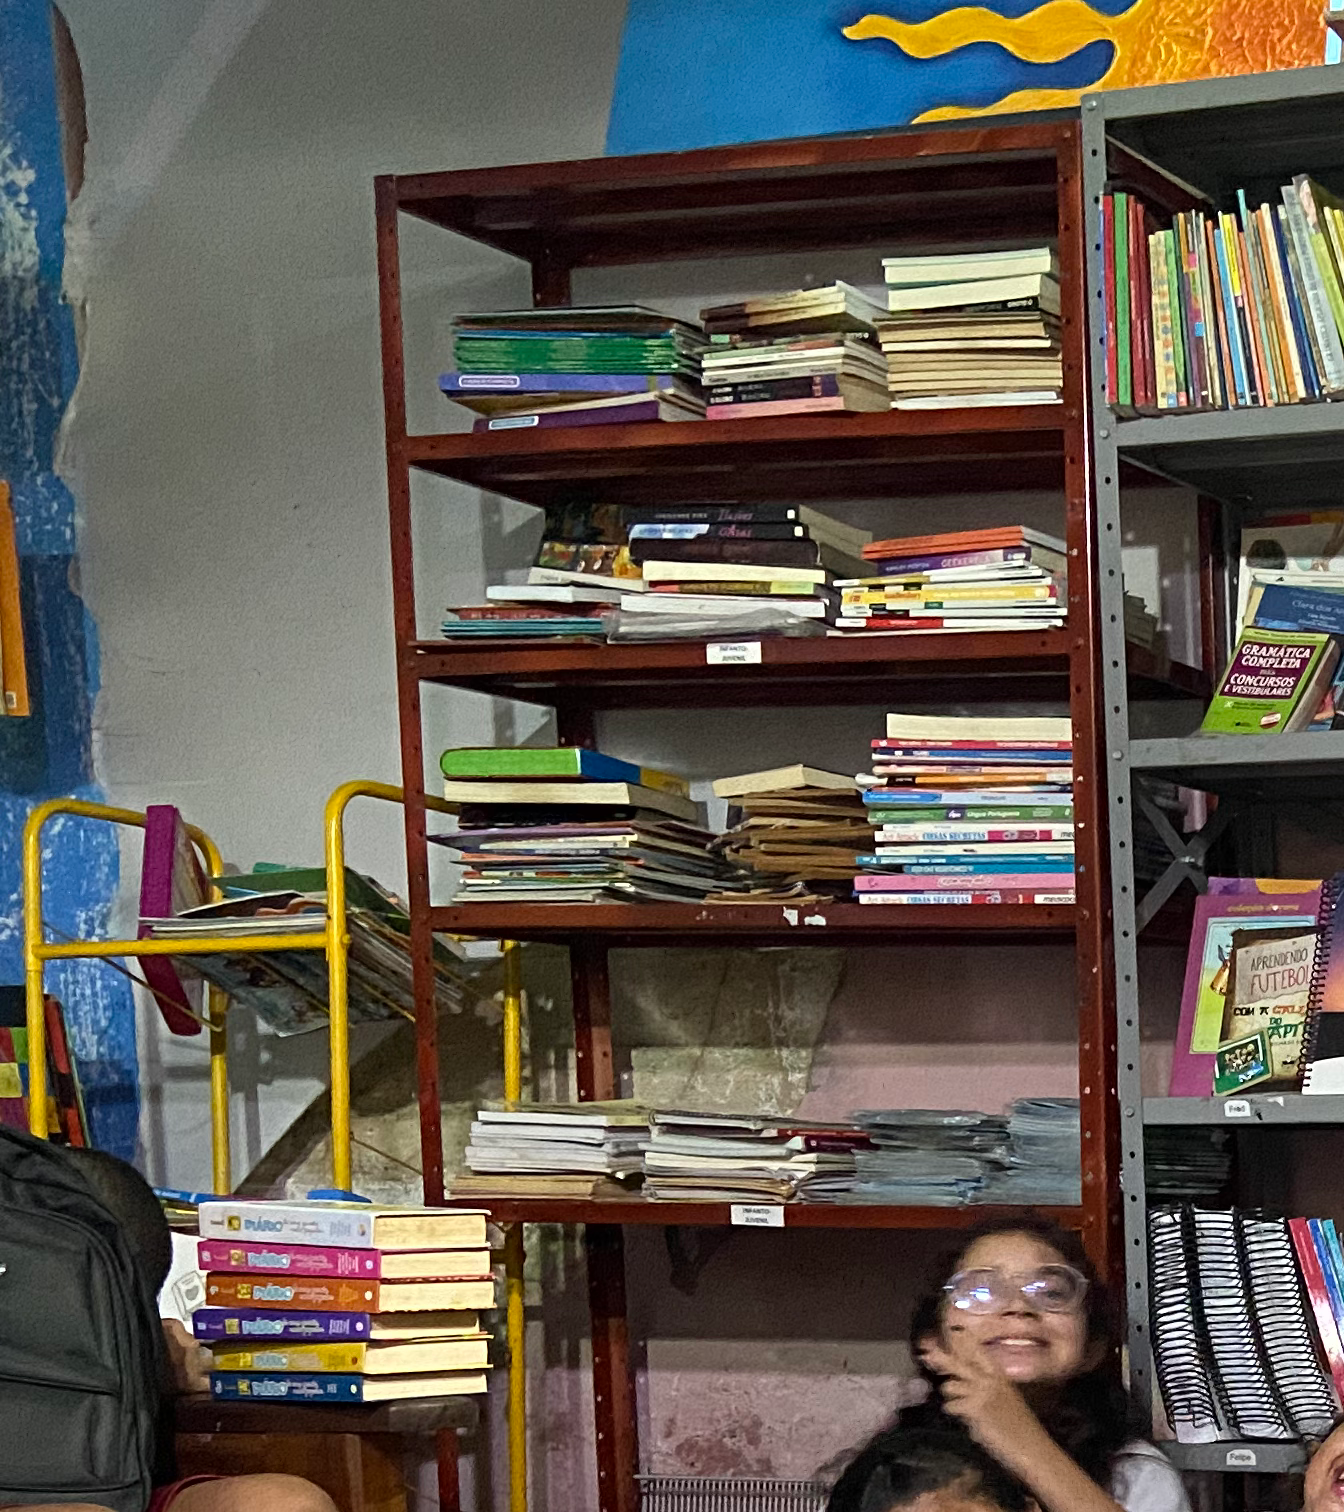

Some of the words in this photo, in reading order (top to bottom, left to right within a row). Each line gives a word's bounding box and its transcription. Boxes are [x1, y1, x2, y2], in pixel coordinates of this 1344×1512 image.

[1241, 643, 1311, 658] GRAMÁTICA
[1241, 656, 1301, 669] COMPLETA
[1230, 673, 1296, 688] CONCURSOS
[1250, 948, 1308, 971] APRENDENDO
